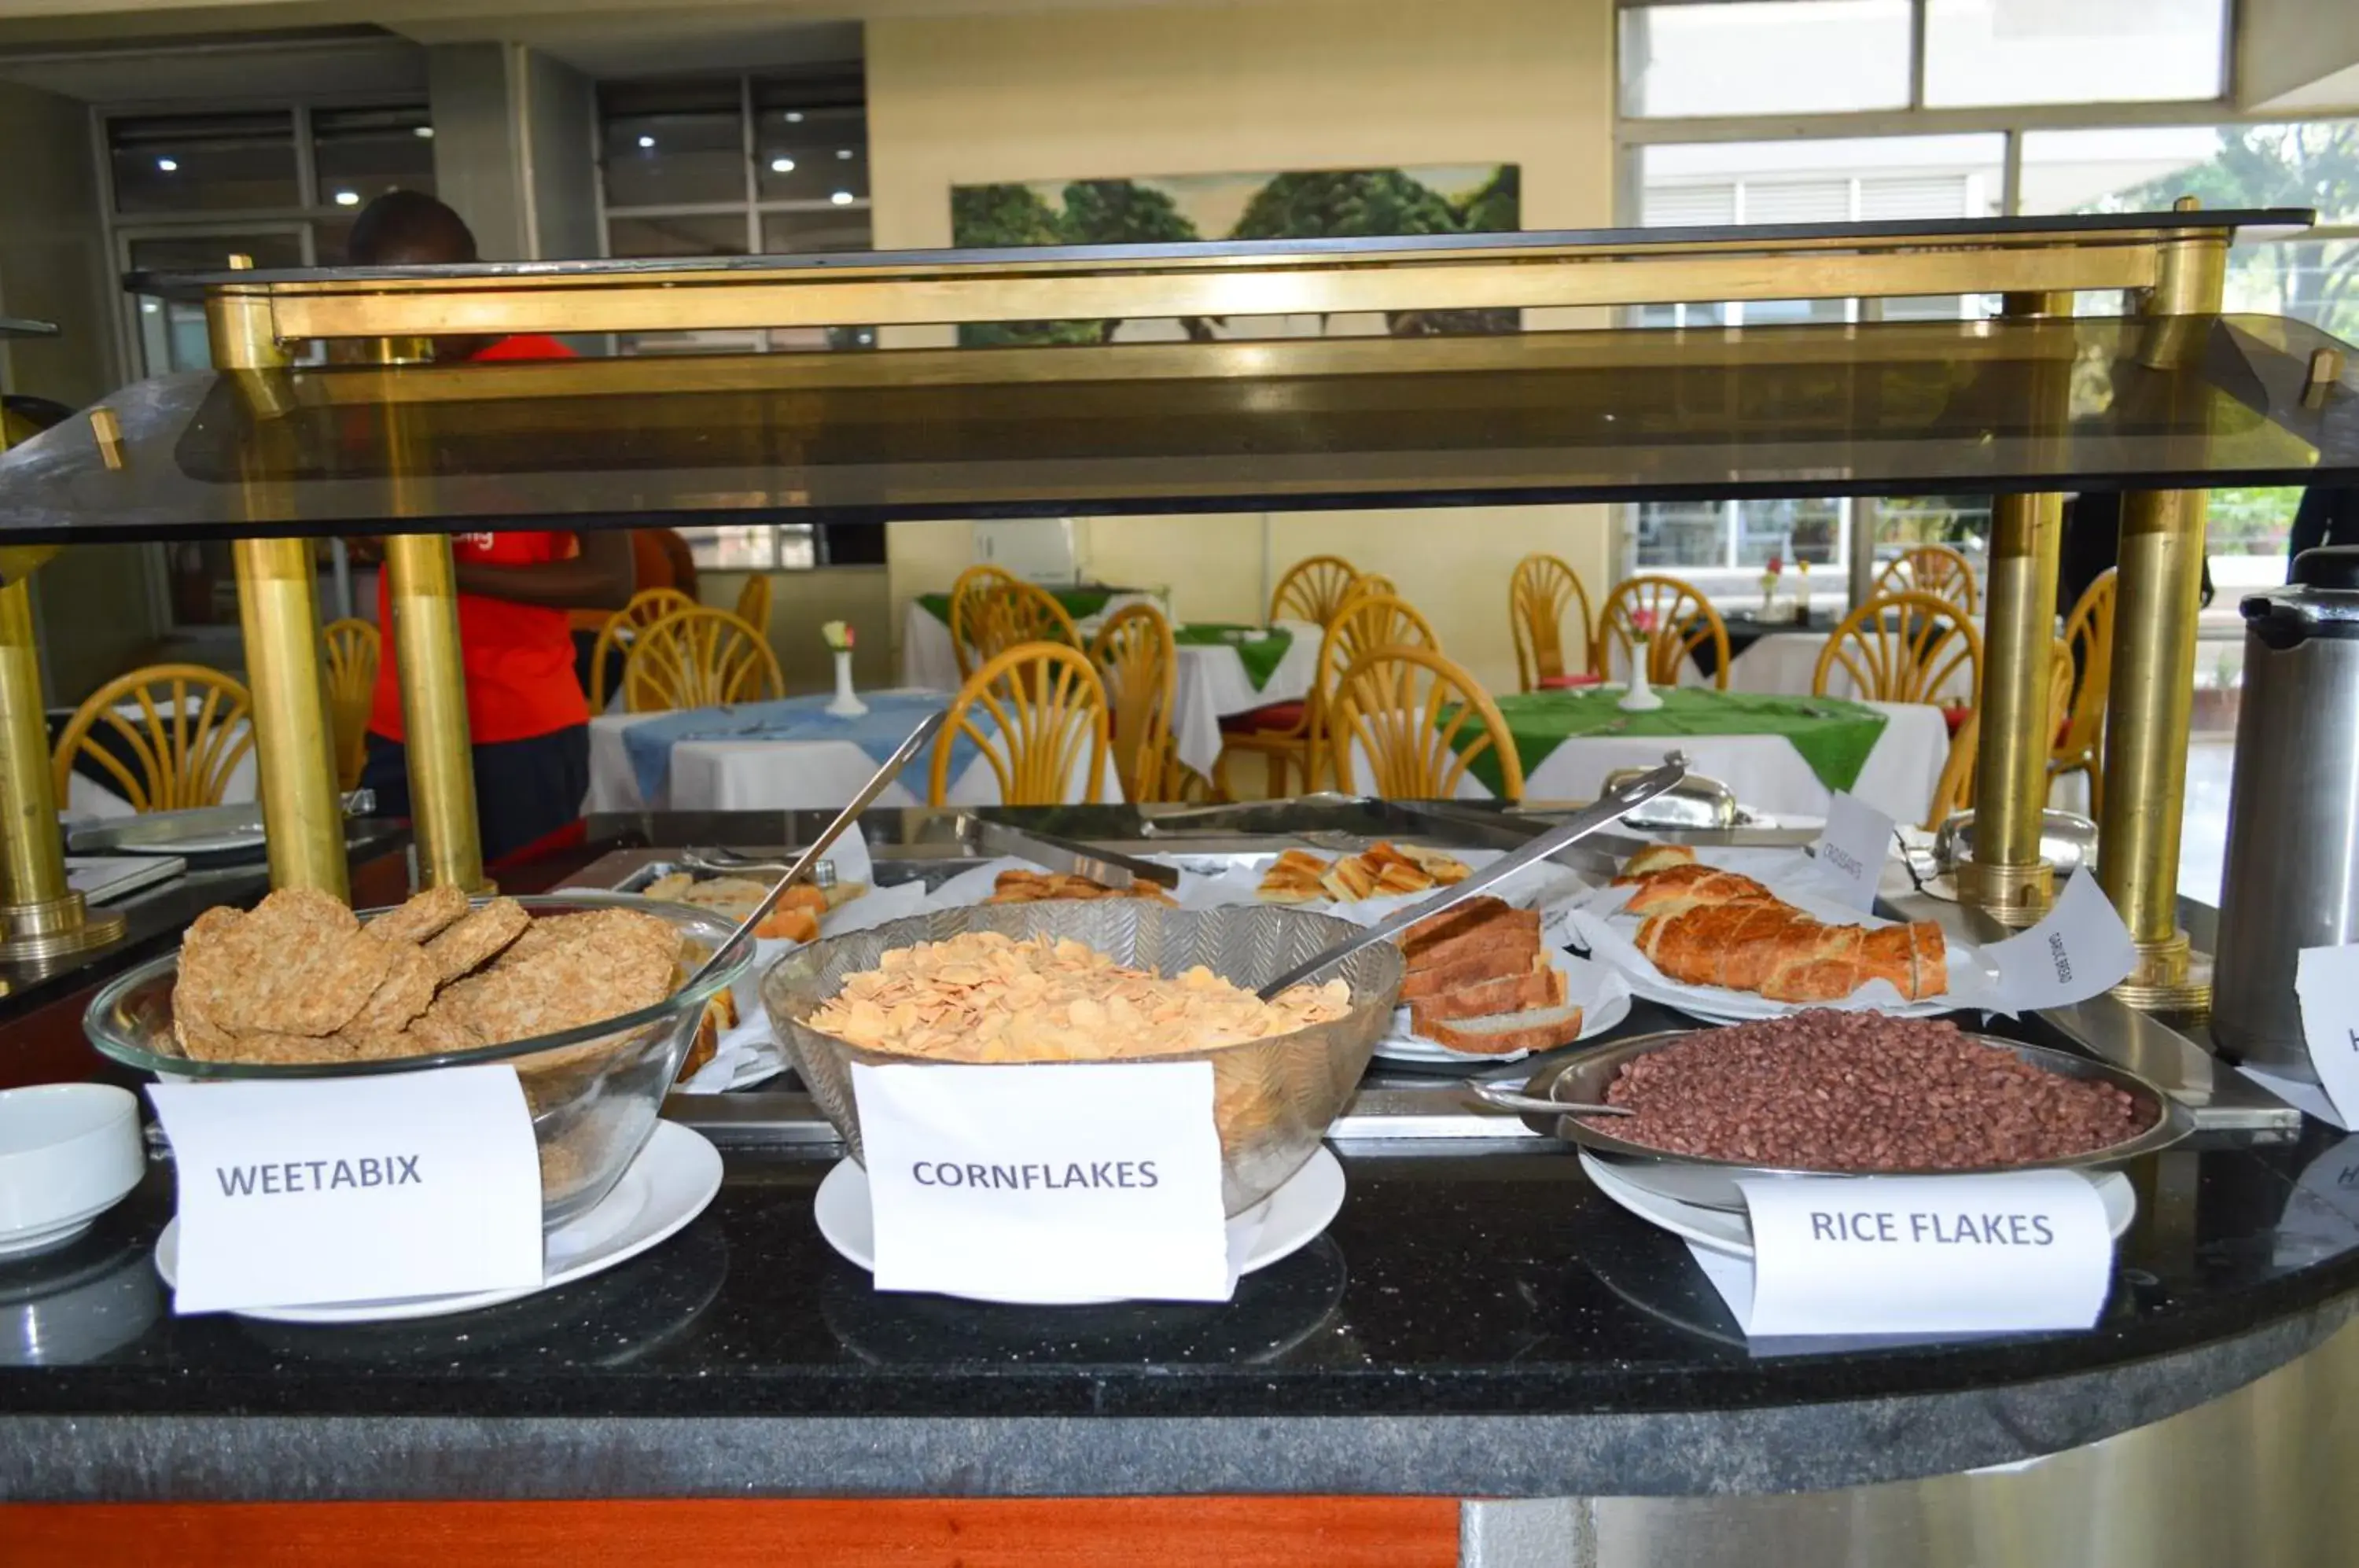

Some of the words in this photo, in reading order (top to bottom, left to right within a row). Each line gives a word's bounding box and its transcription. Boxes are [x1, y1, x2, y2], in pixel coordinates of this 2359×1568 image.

[216, 1154, 422, 1197] WEETABIX
[912, 1161, 1159, 1190] CORNFLAKES
[1810, 1212, 1898, 1242] RICE
[1909, 1213, 2055, 1246] FLAKES
